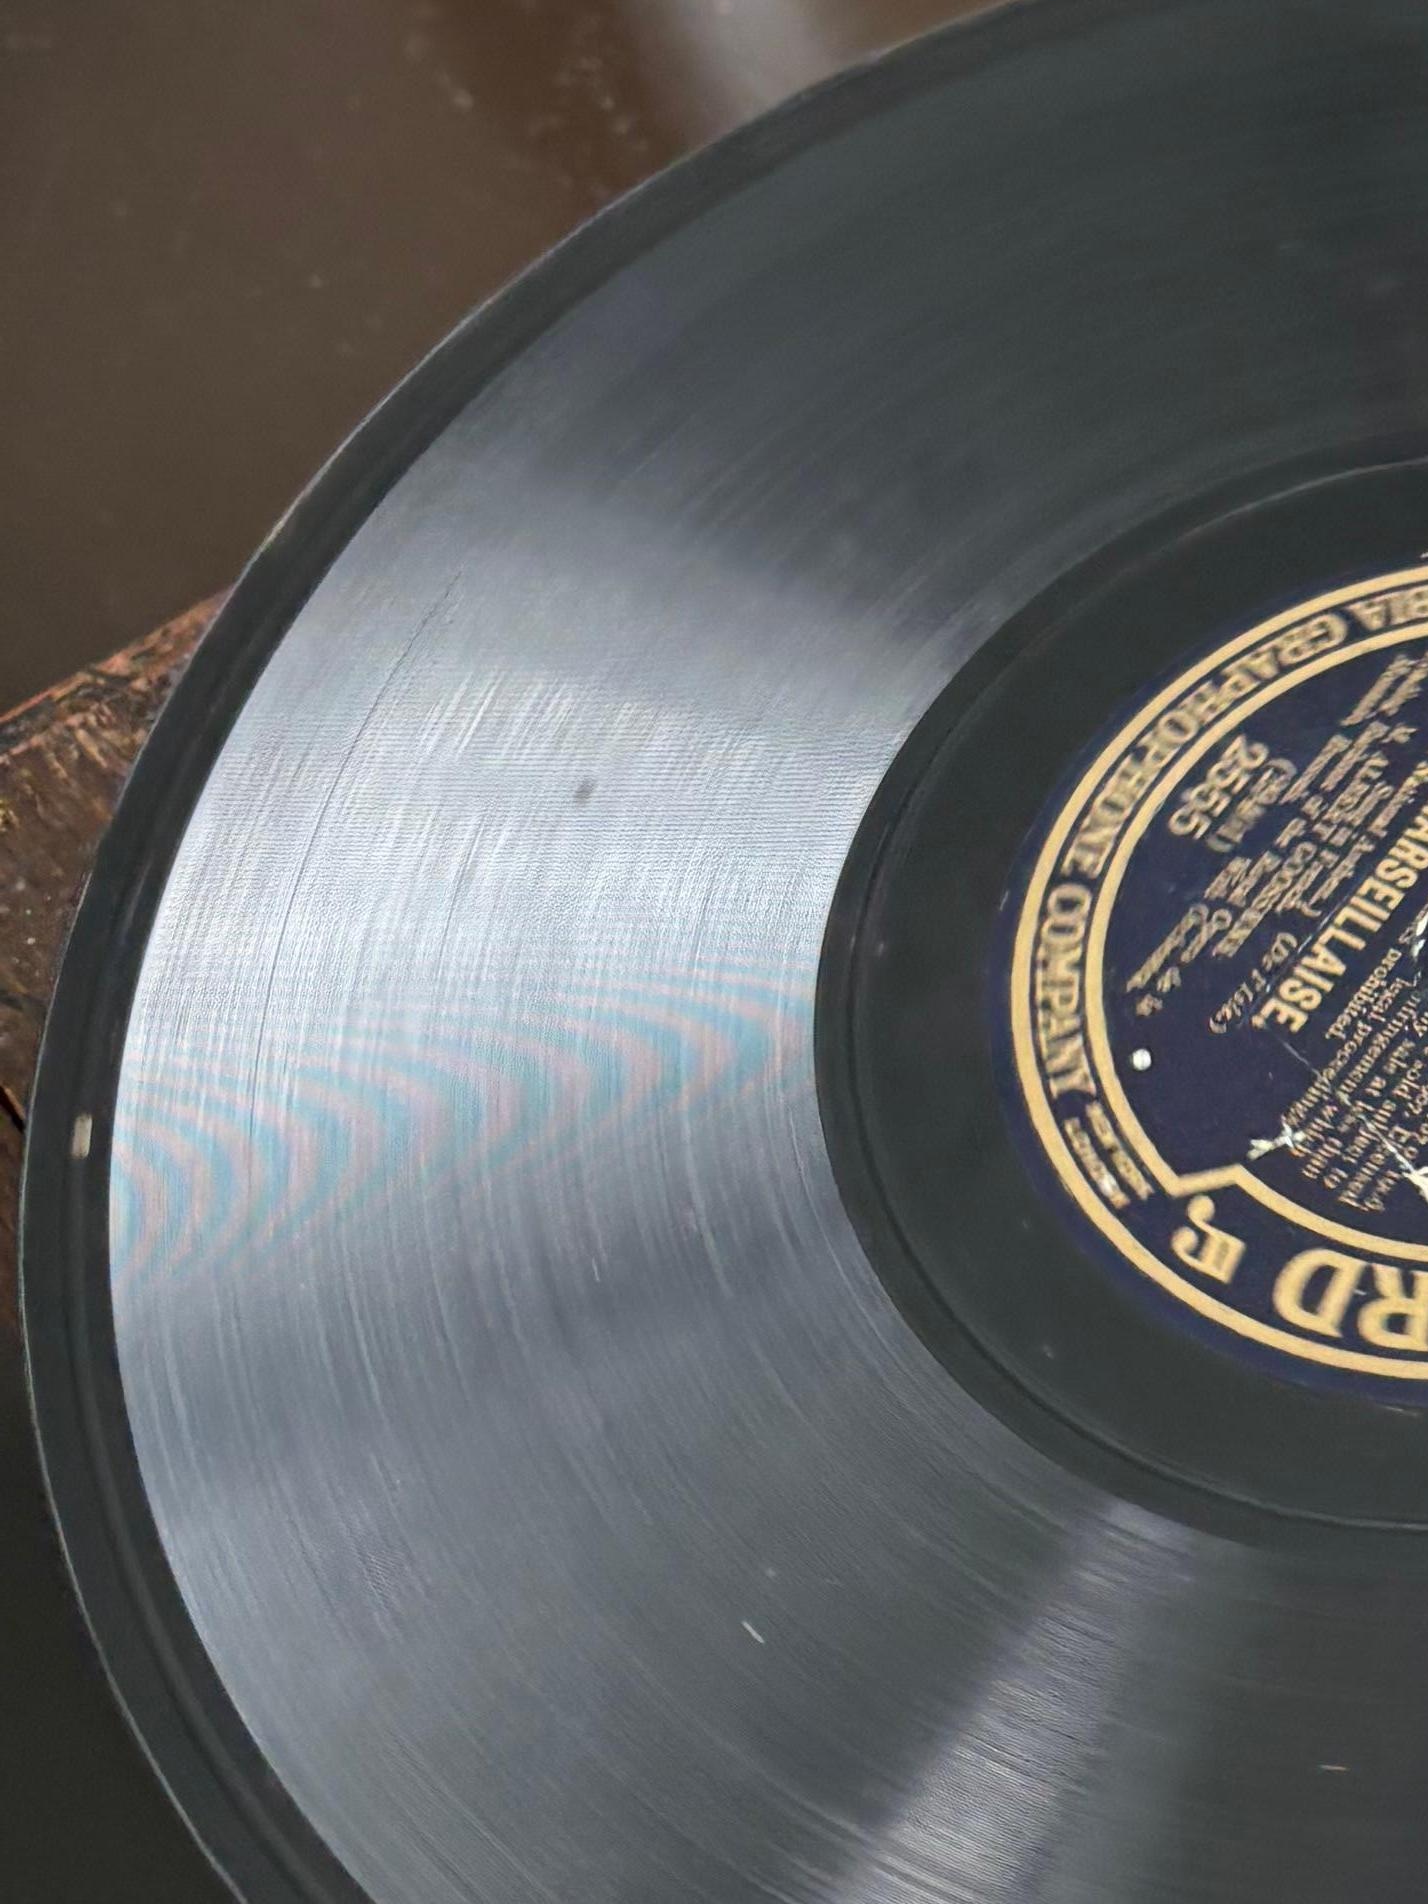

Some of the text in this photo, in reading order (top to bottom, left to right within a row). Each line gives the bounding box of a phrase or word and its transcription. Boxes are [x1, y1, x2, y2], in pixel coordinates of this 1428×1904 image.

[1062, 617, 1350, 879] GRAPHOPHONE
[1169, 736, 1267, 837] 2555
[1035, 884, 1094, 1097] COMPANY
[1325, 948, 1401, 1039] prohibited.
[1364, 1075, 1386, 1097] at
[1383, 1038, 1415, 1074] sale
[1391, 1059, 1423, 1100] sold
[1323, 1167, 1348, 1189] to
